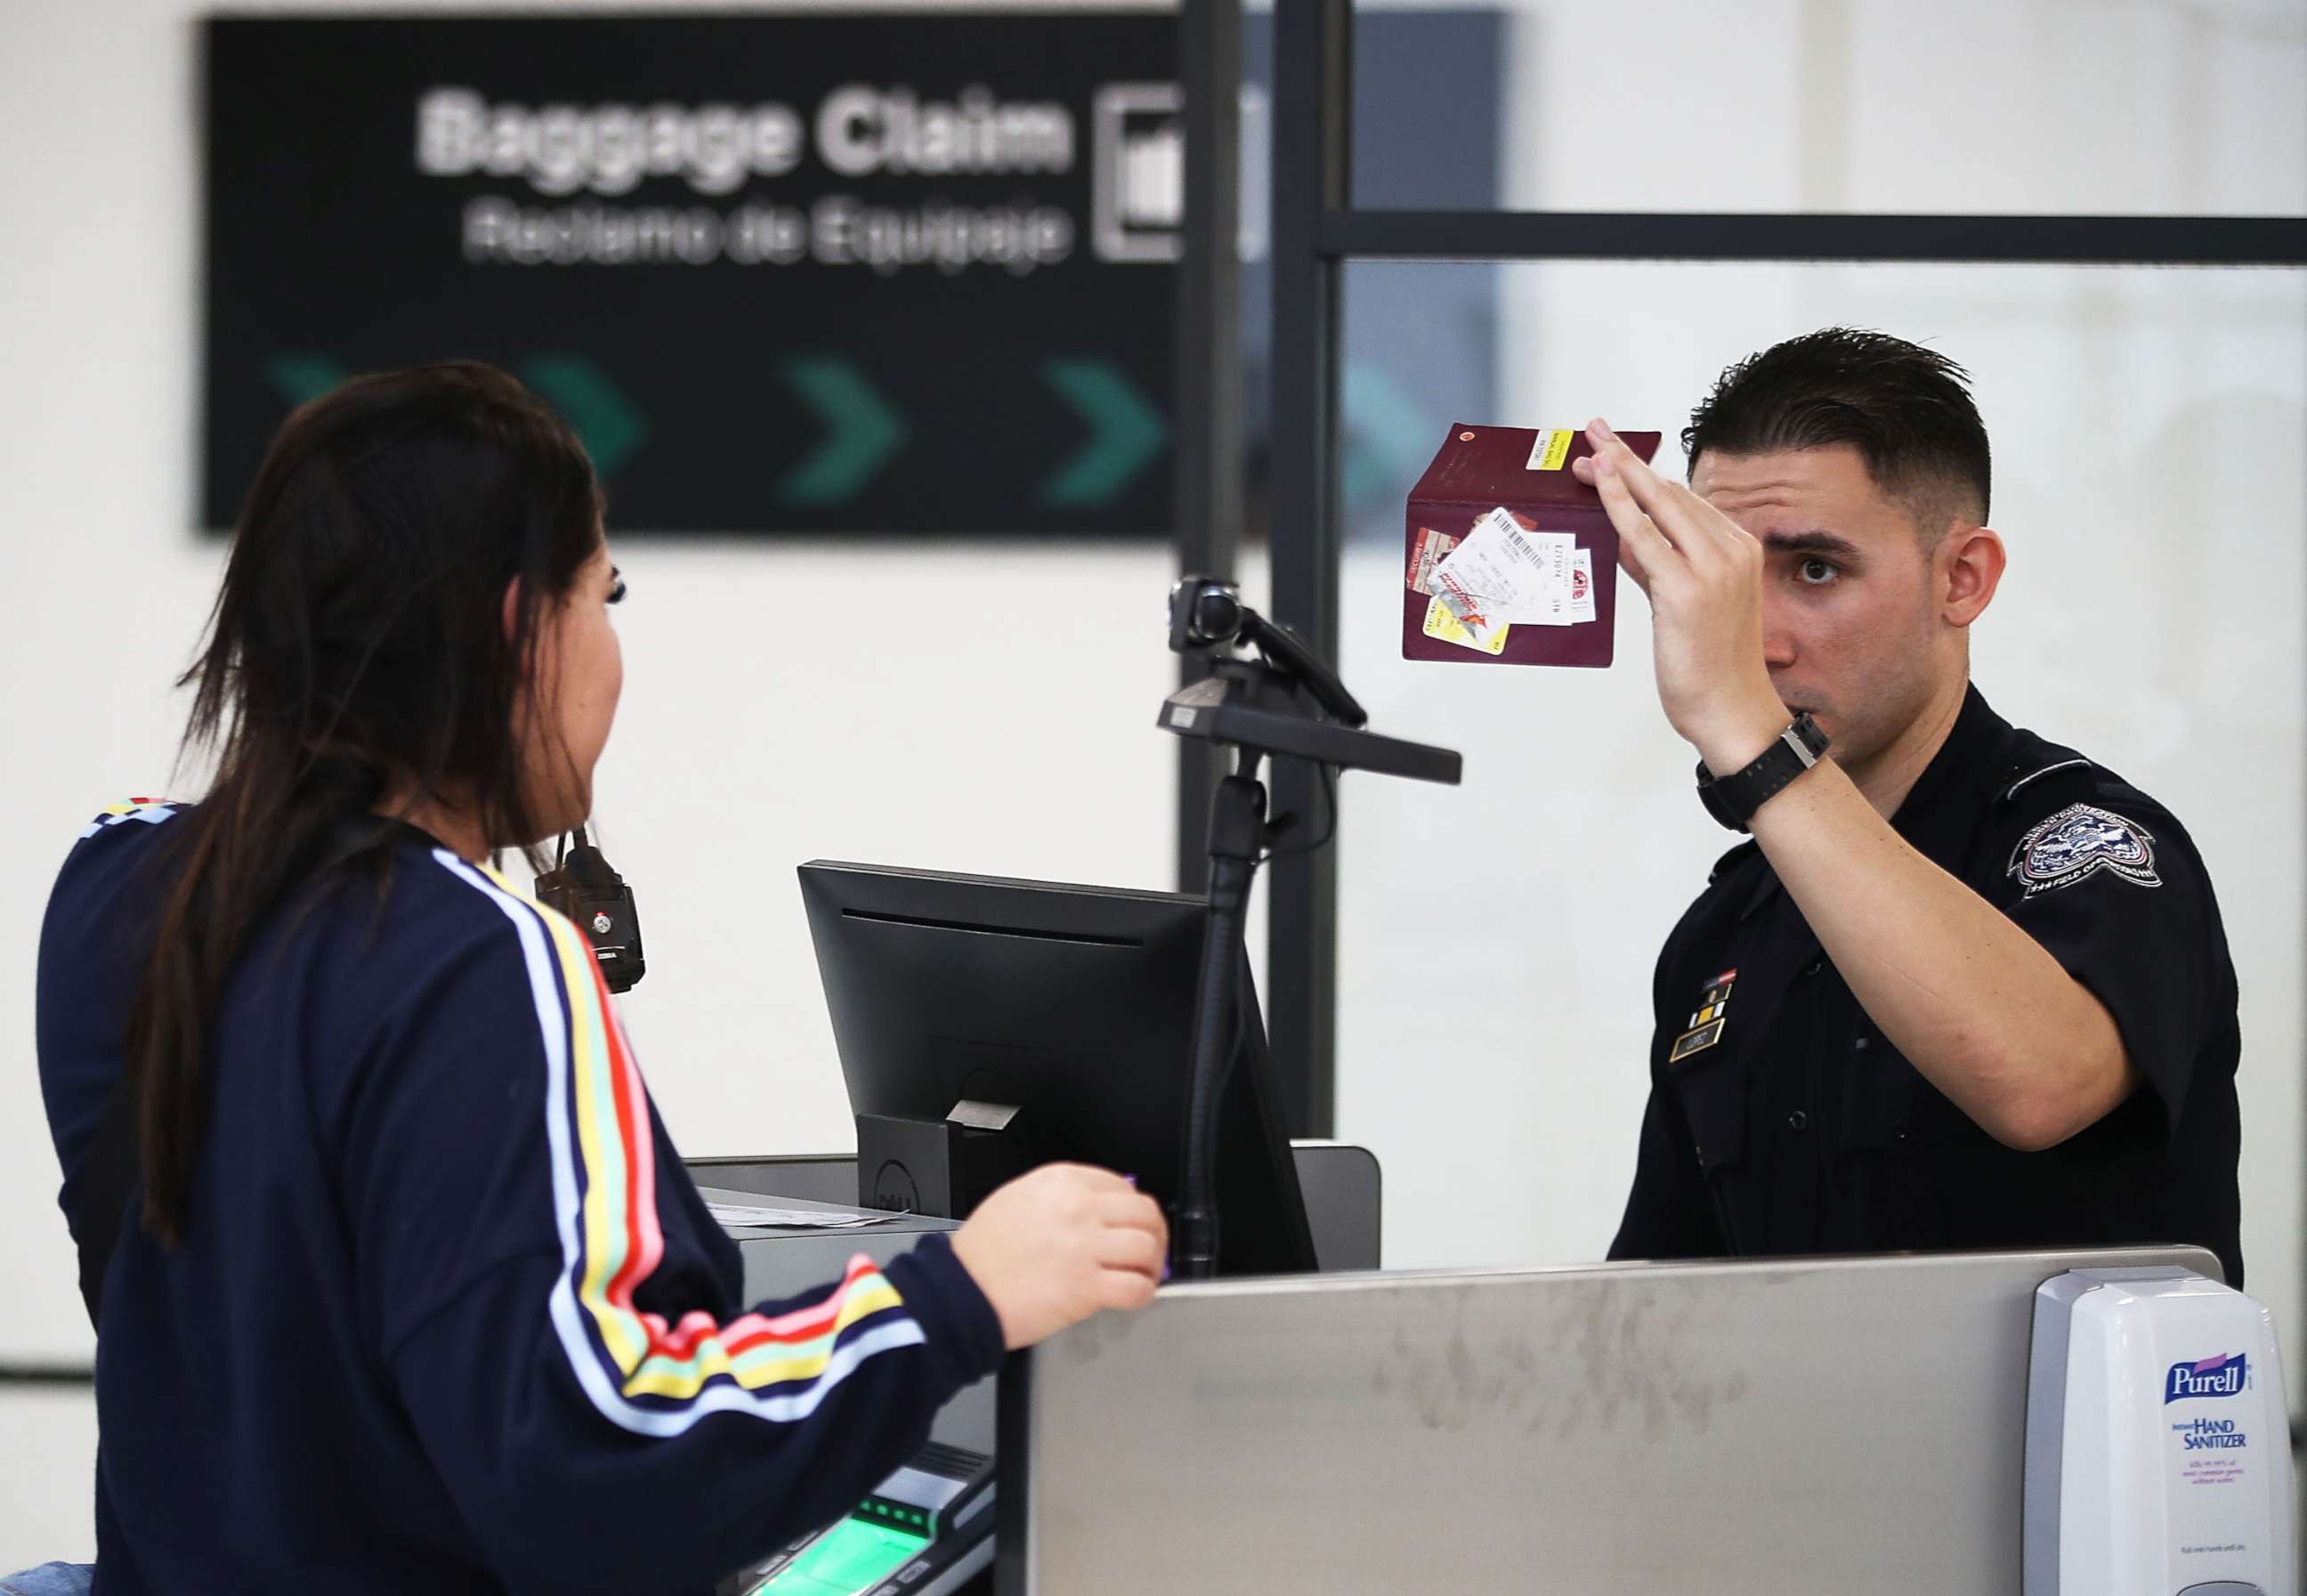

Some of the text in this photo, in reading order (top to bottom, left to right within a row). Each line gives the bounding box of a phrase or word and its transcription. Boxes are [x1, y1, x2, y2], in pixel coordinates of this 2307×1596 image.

[418, 87, 1073, 195] Baggage Claim
[464, 197, 1073, 276] Reclamo de Equipaje
[2052, 871, 2081, 887] FIELD
[2172, 1365, 2238, 1395] Purell
[2194, 1418, 2234, 1435] HAND
[2183, 1433, 2246, 1450] SANITIZER
